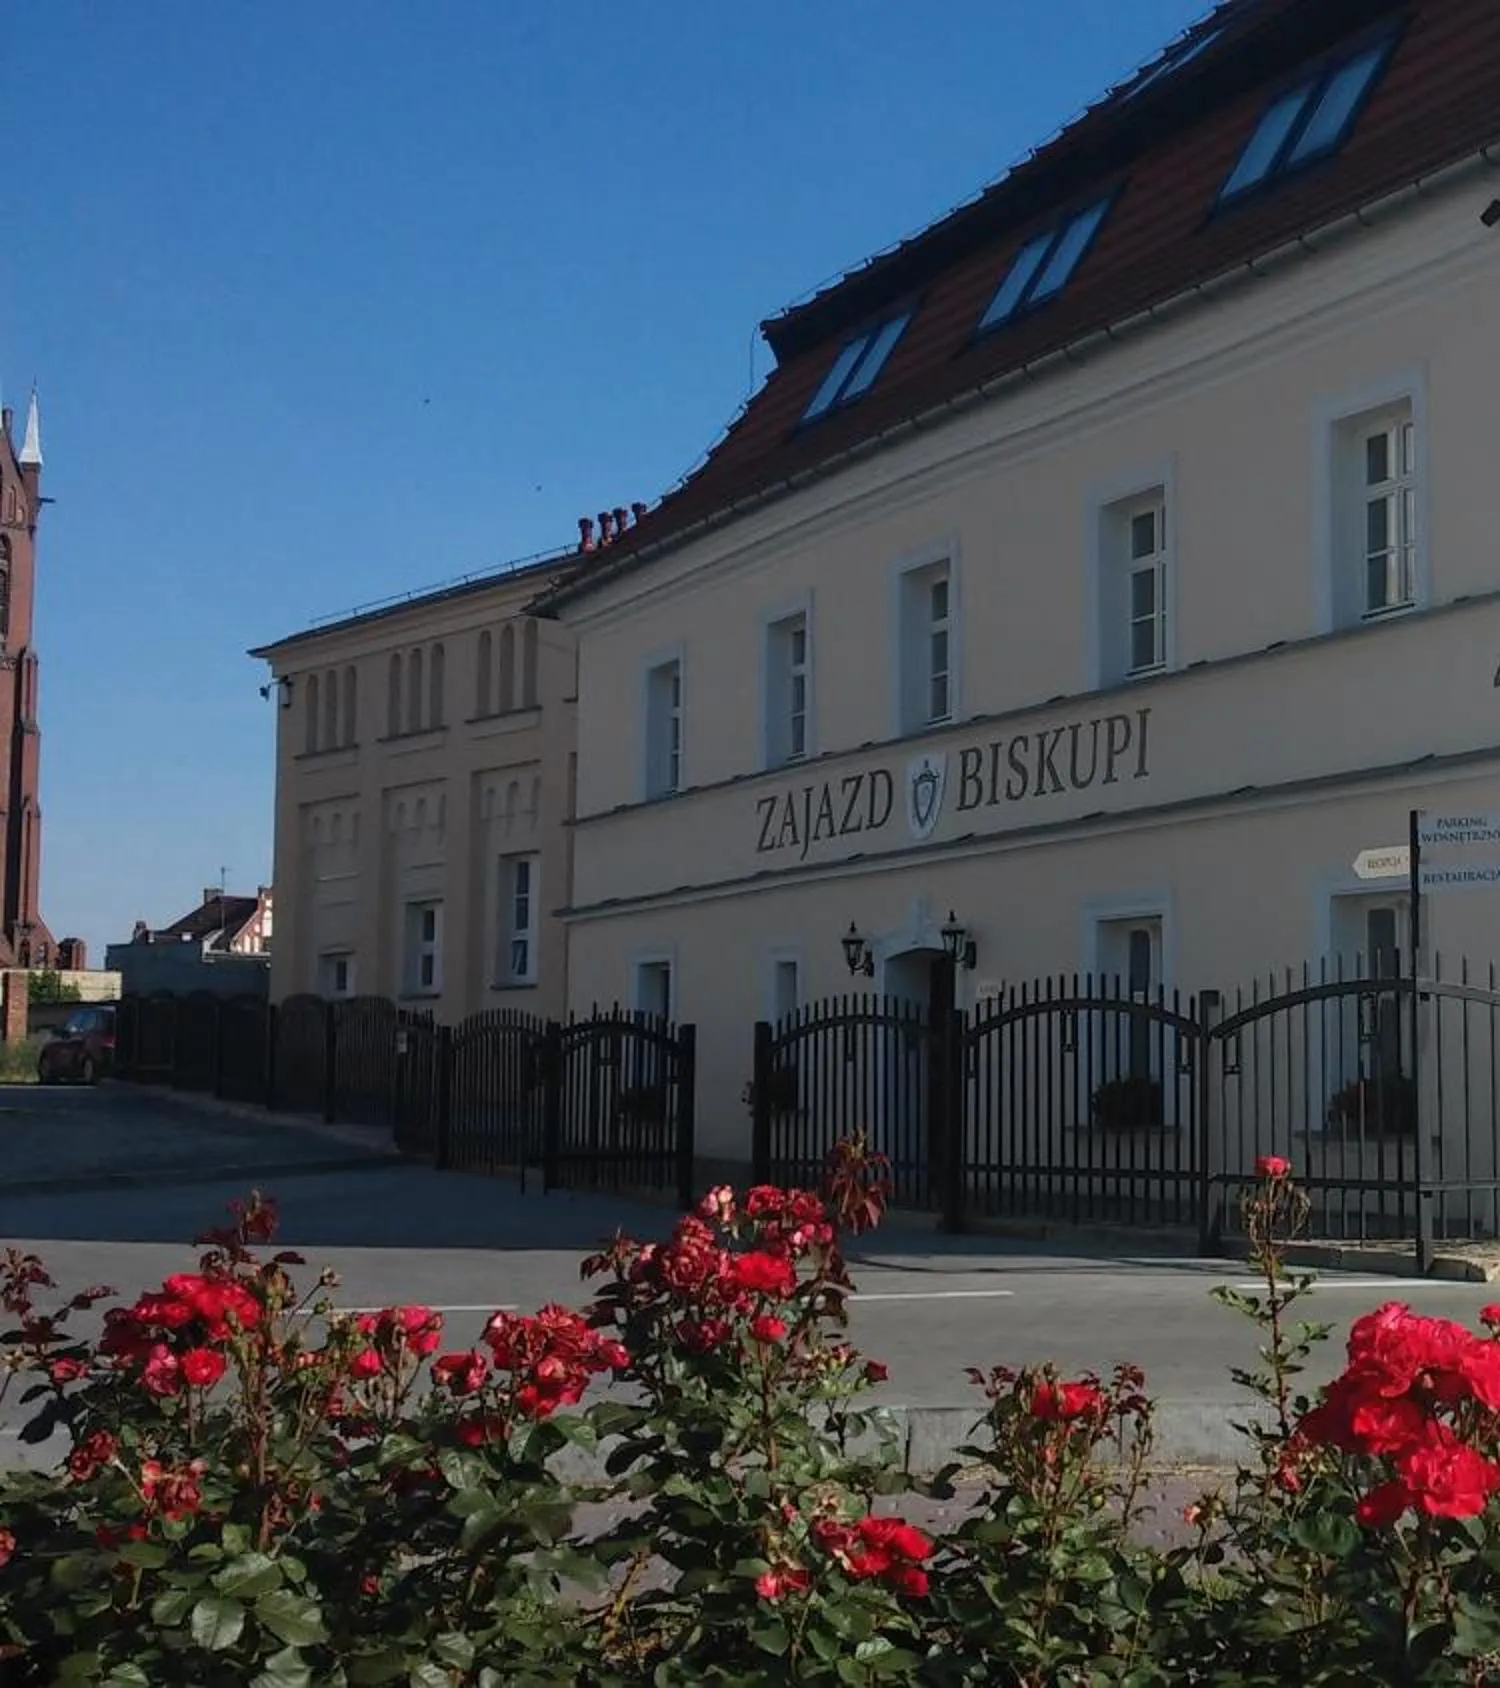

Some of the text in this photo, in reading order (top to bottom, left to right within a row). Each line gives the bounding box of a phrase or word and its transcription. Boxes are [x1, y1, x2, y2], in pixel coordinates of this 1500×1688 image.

[755, 707, 1152, 860] ZAJAZD BISKUPI
[1436, 816, 1487, 829] PARKING
